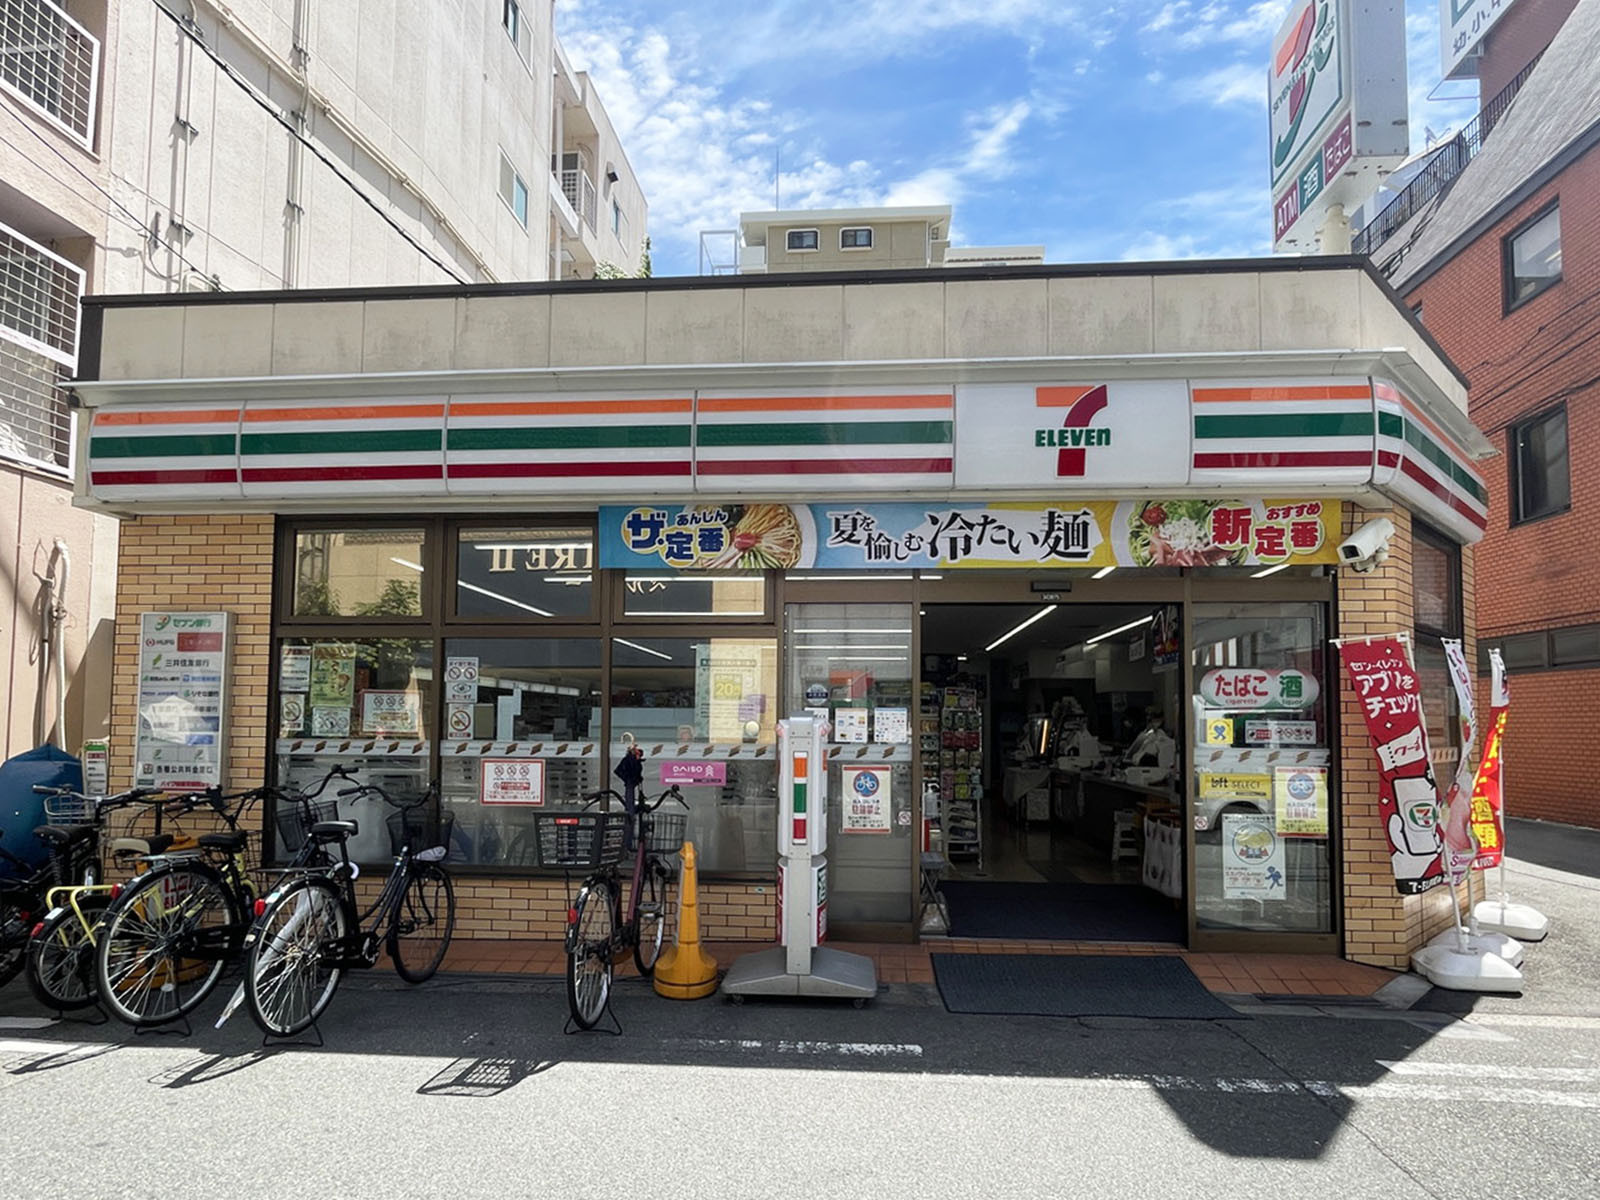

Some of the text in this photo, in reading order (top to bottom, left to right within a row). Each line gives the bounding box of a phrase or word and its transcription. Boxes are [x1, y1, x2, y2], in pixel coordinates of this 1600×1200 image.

[1303, 161, 1319, 205] 酒
[1277, 190, 1297, 234] ATM
[676, 510, 727, 526] あんしん
[1266, 502, 1321, 520] おすすめ
[1212, 507, 1318, 556] 新定番
[1215, 674, 1303, 698] たばこ 酒
[1356, 670, 1414, 696] アプリを
[1365, 692, 1417, 719] チェック
